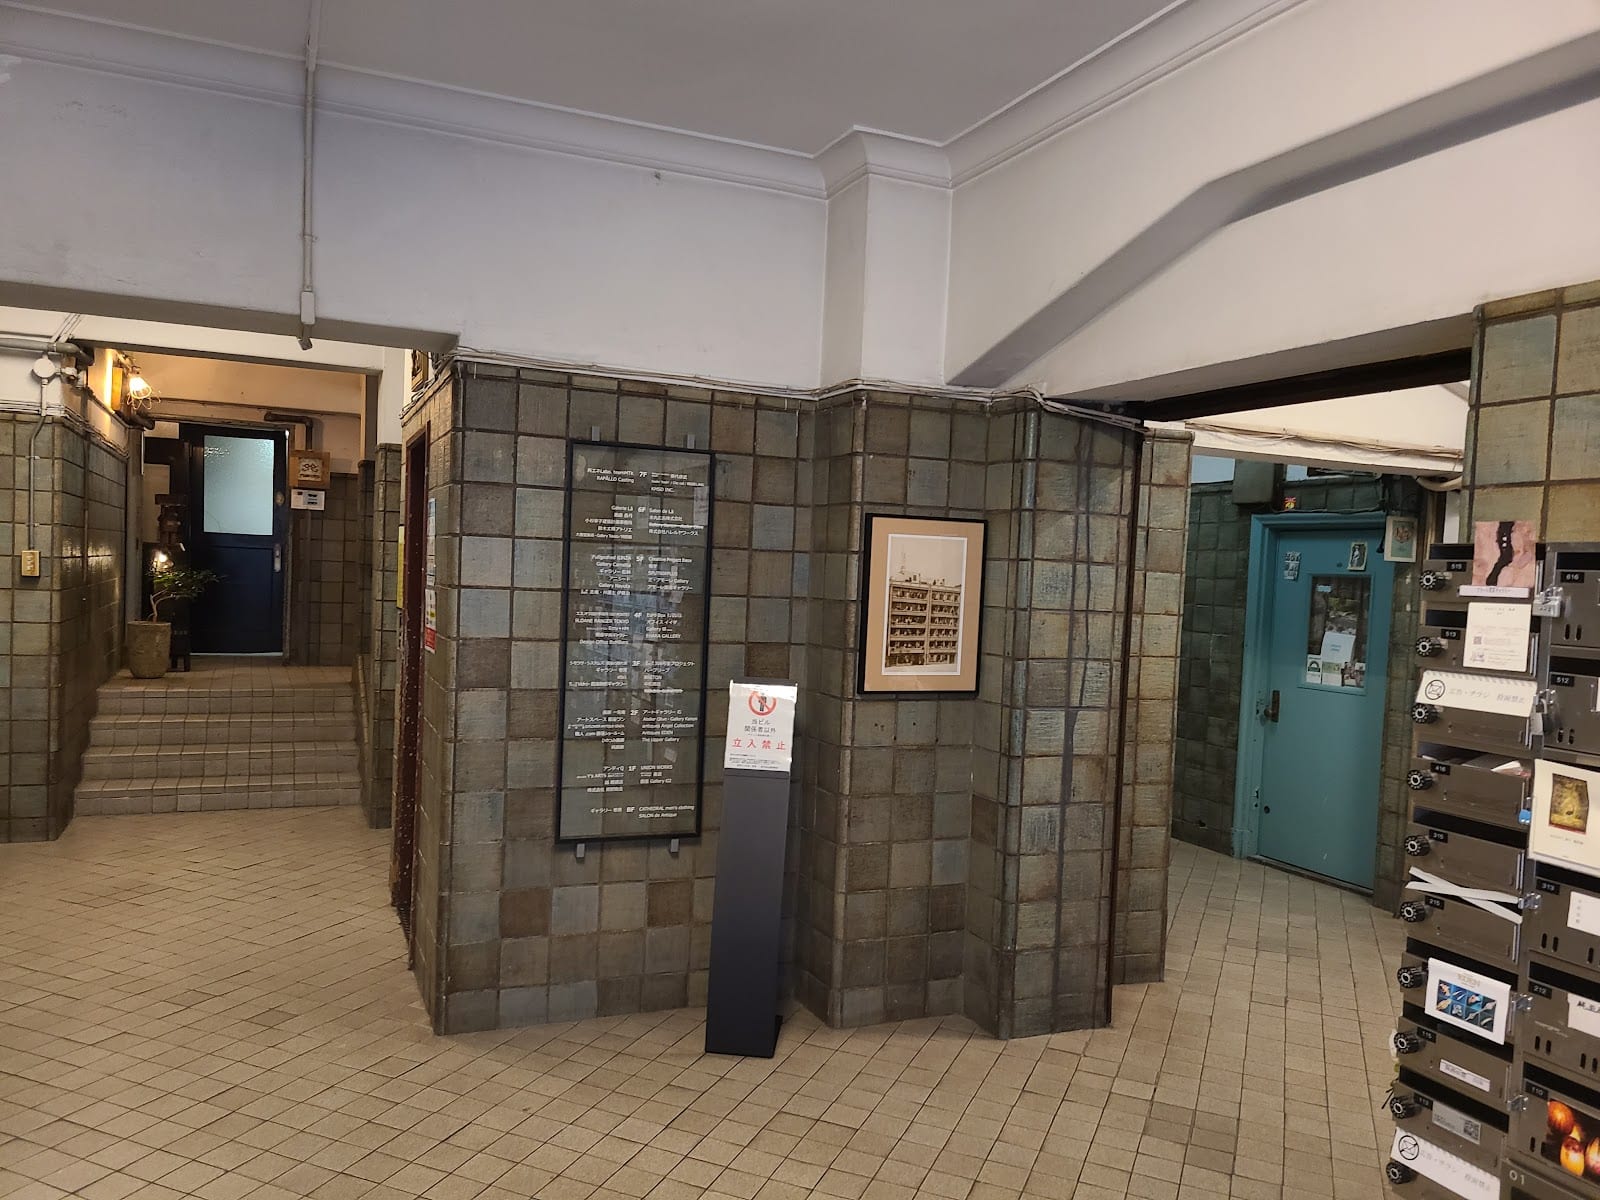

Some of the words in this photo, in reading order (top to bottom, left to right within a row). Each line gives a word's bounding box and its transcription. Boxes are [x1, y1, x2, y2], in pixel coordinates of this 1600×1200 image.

[744, 726, 776, 734] 関係者以外
[732, 738, 786, 751] 立入禁止
[1509, 1170, 1525, 1185] 01
